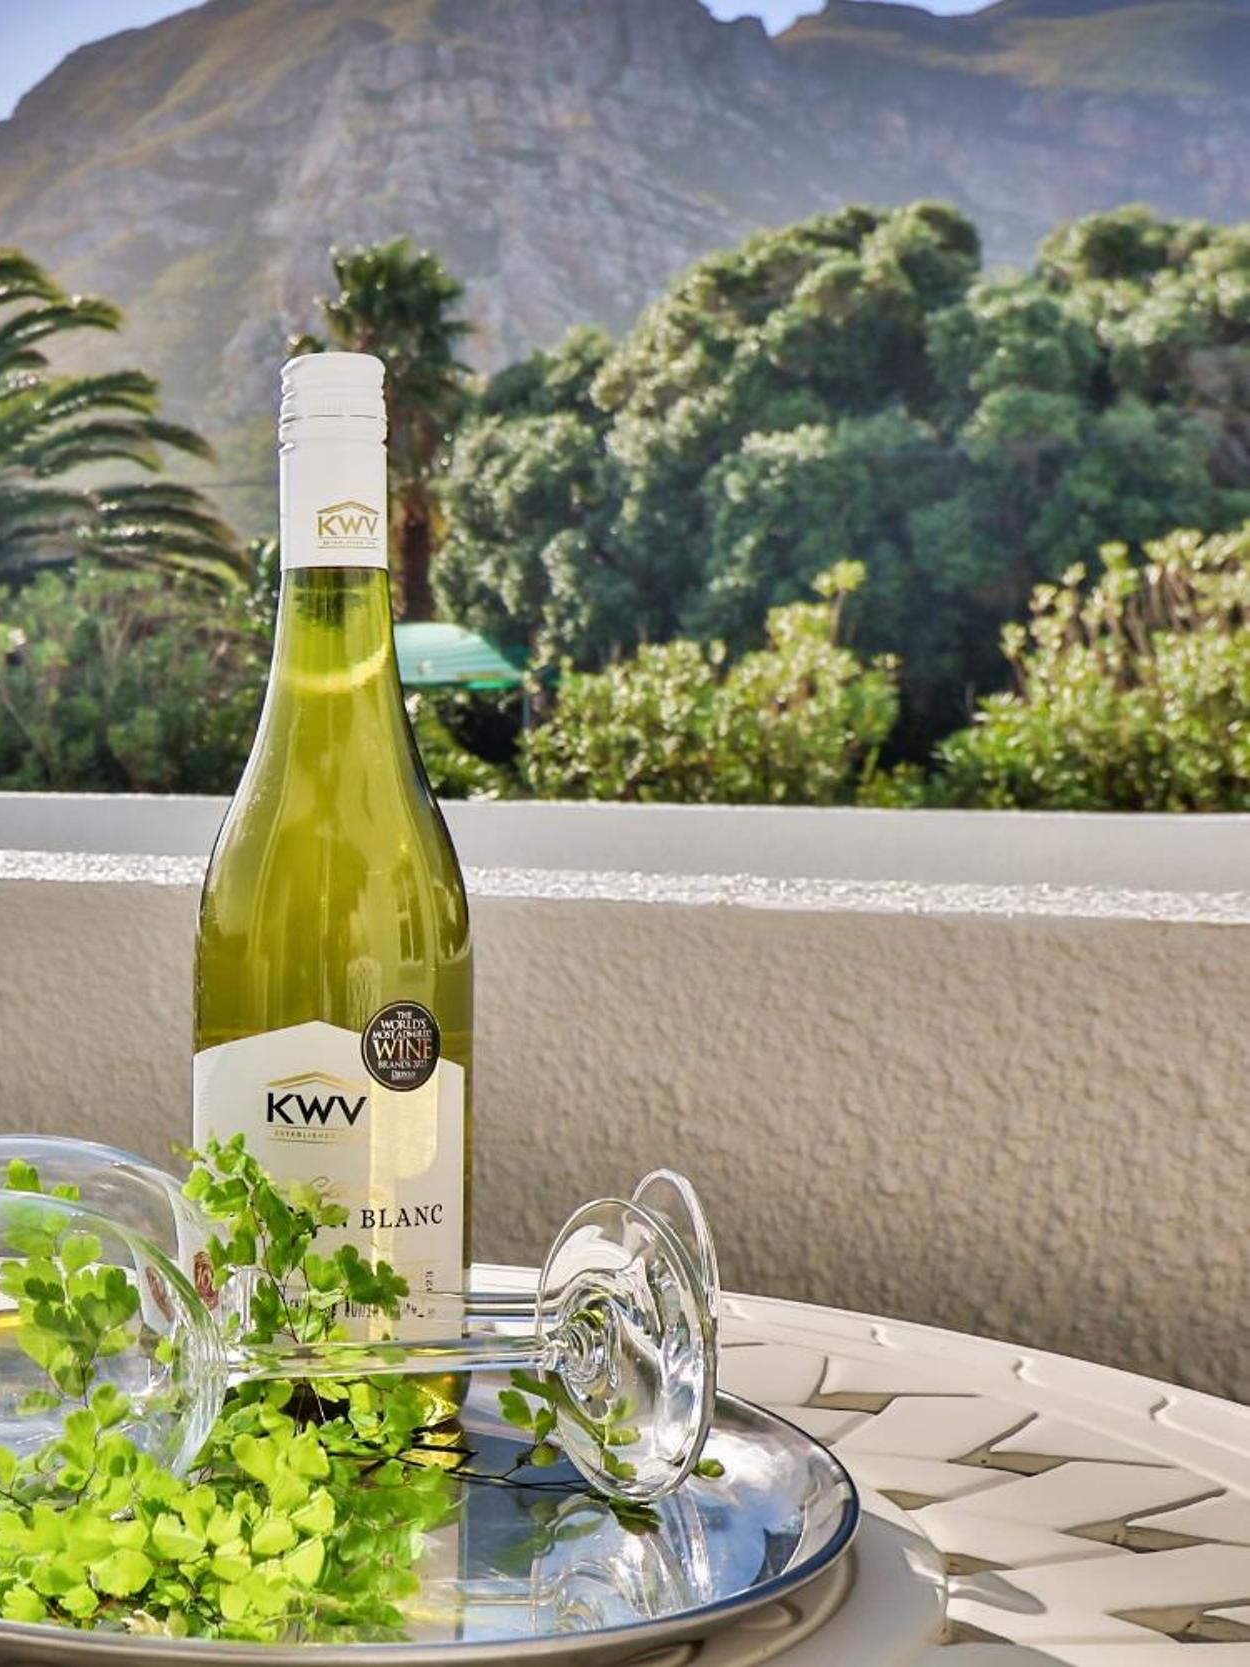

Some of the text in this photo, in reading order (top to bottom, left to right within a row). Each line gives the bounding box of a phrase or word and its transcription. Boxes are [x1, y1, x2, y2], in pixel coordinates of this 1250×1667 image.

[317, 515, 378, 536] KWV
[396, 1011, 412, 1019] THE
[372, 1031, 395, 1040] MOST
[373, 1039, 432, 1060] WINE
[267, 1093, 367, 1126] KWV
[360, 1204, 443, 1229] BLANC
